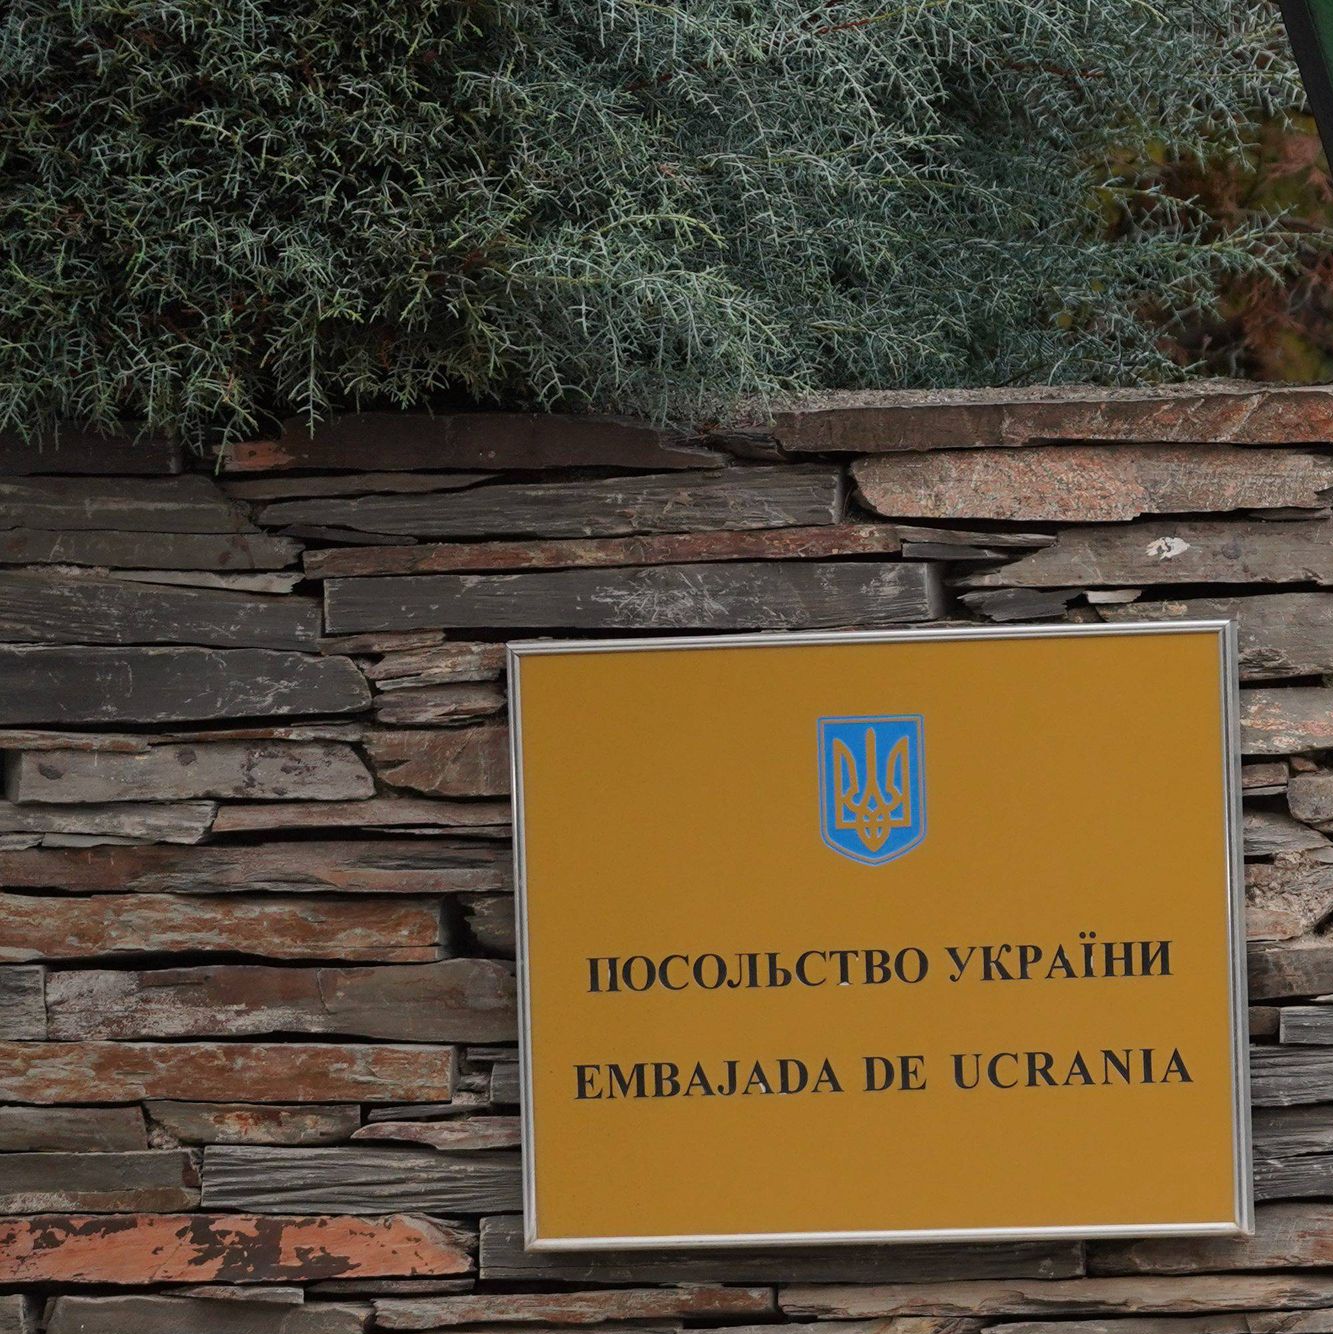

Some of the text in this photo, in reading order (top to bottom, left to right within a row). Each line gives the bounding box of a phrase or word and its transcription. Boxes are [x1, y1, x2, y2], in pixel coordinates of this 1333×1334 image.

[586, 931, 1173, 993] ПОСОЛЬСТВО УКРАЇНИ
[573, 1047, 1194, 1100] EMBAJADA DE UCRANIA
